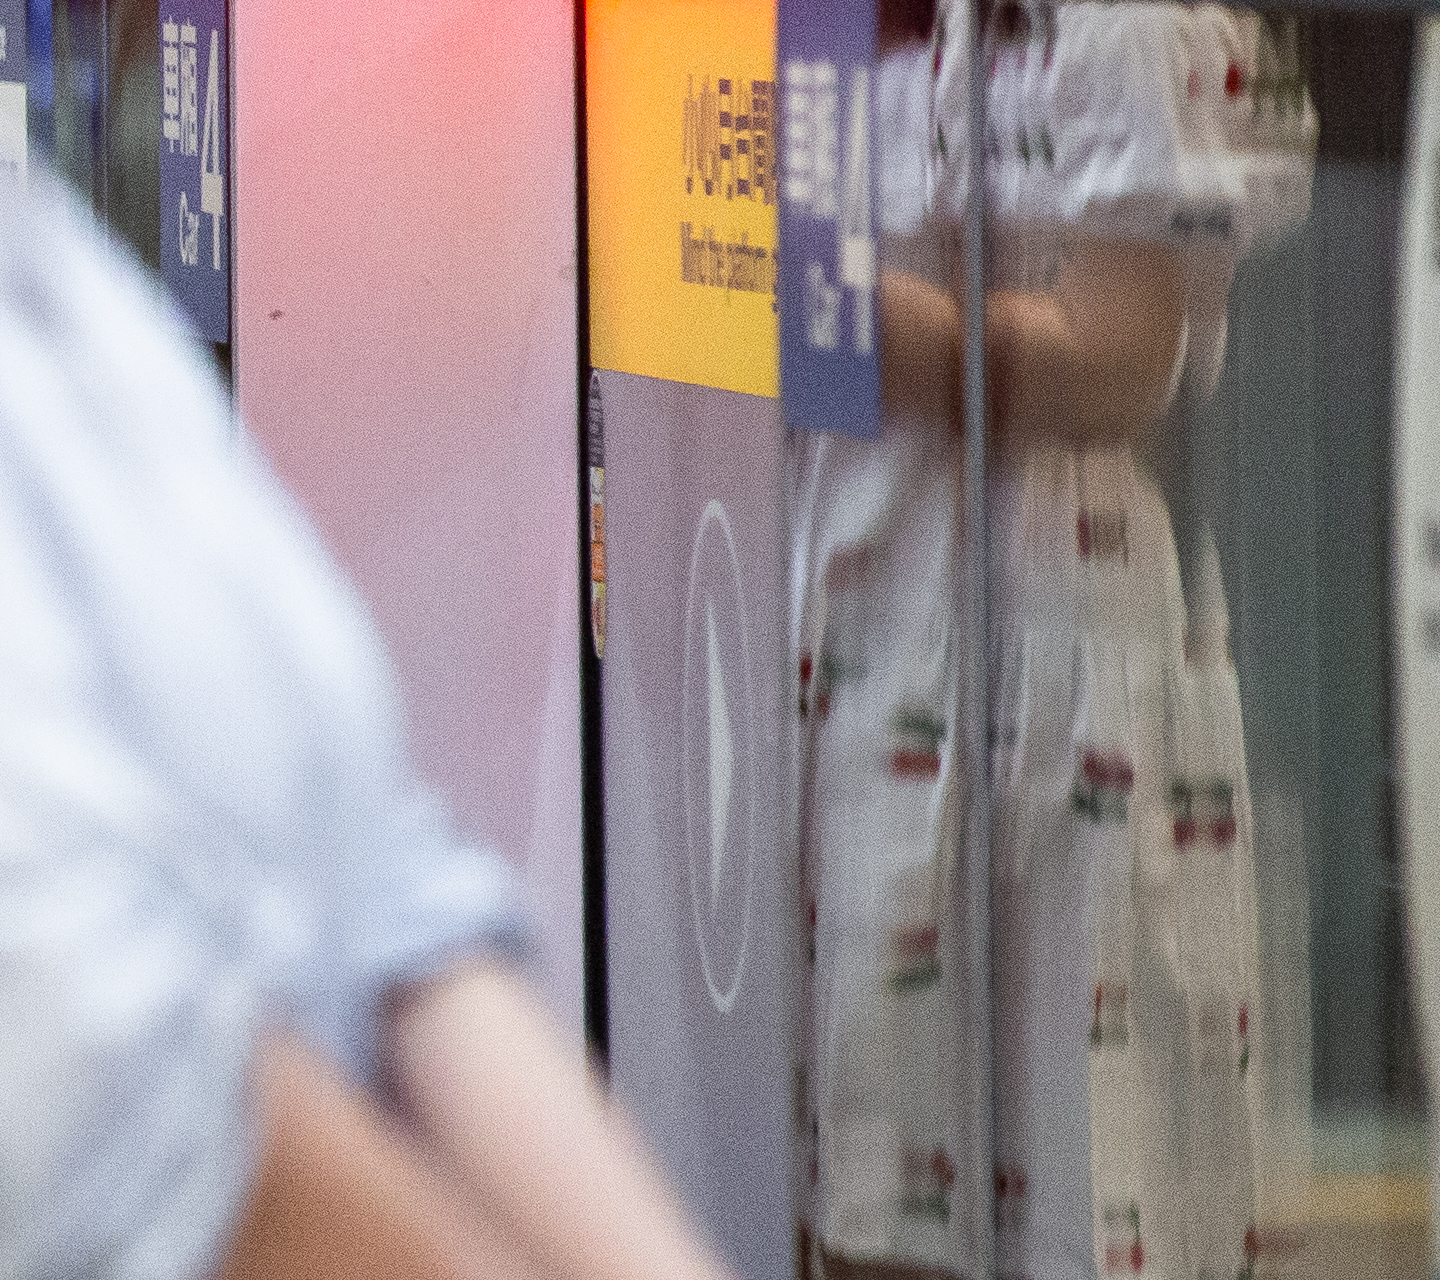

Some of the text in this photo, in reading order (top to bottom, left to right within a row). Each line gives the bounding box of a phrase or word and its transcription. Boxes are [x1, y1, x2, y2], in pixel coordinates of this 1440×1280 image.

[162, 14, 198, 156] 車廂
[201, 28, 224, 270] 4
[178, 191, 199, 266] Car
[840, 64, 875, 353] 4
